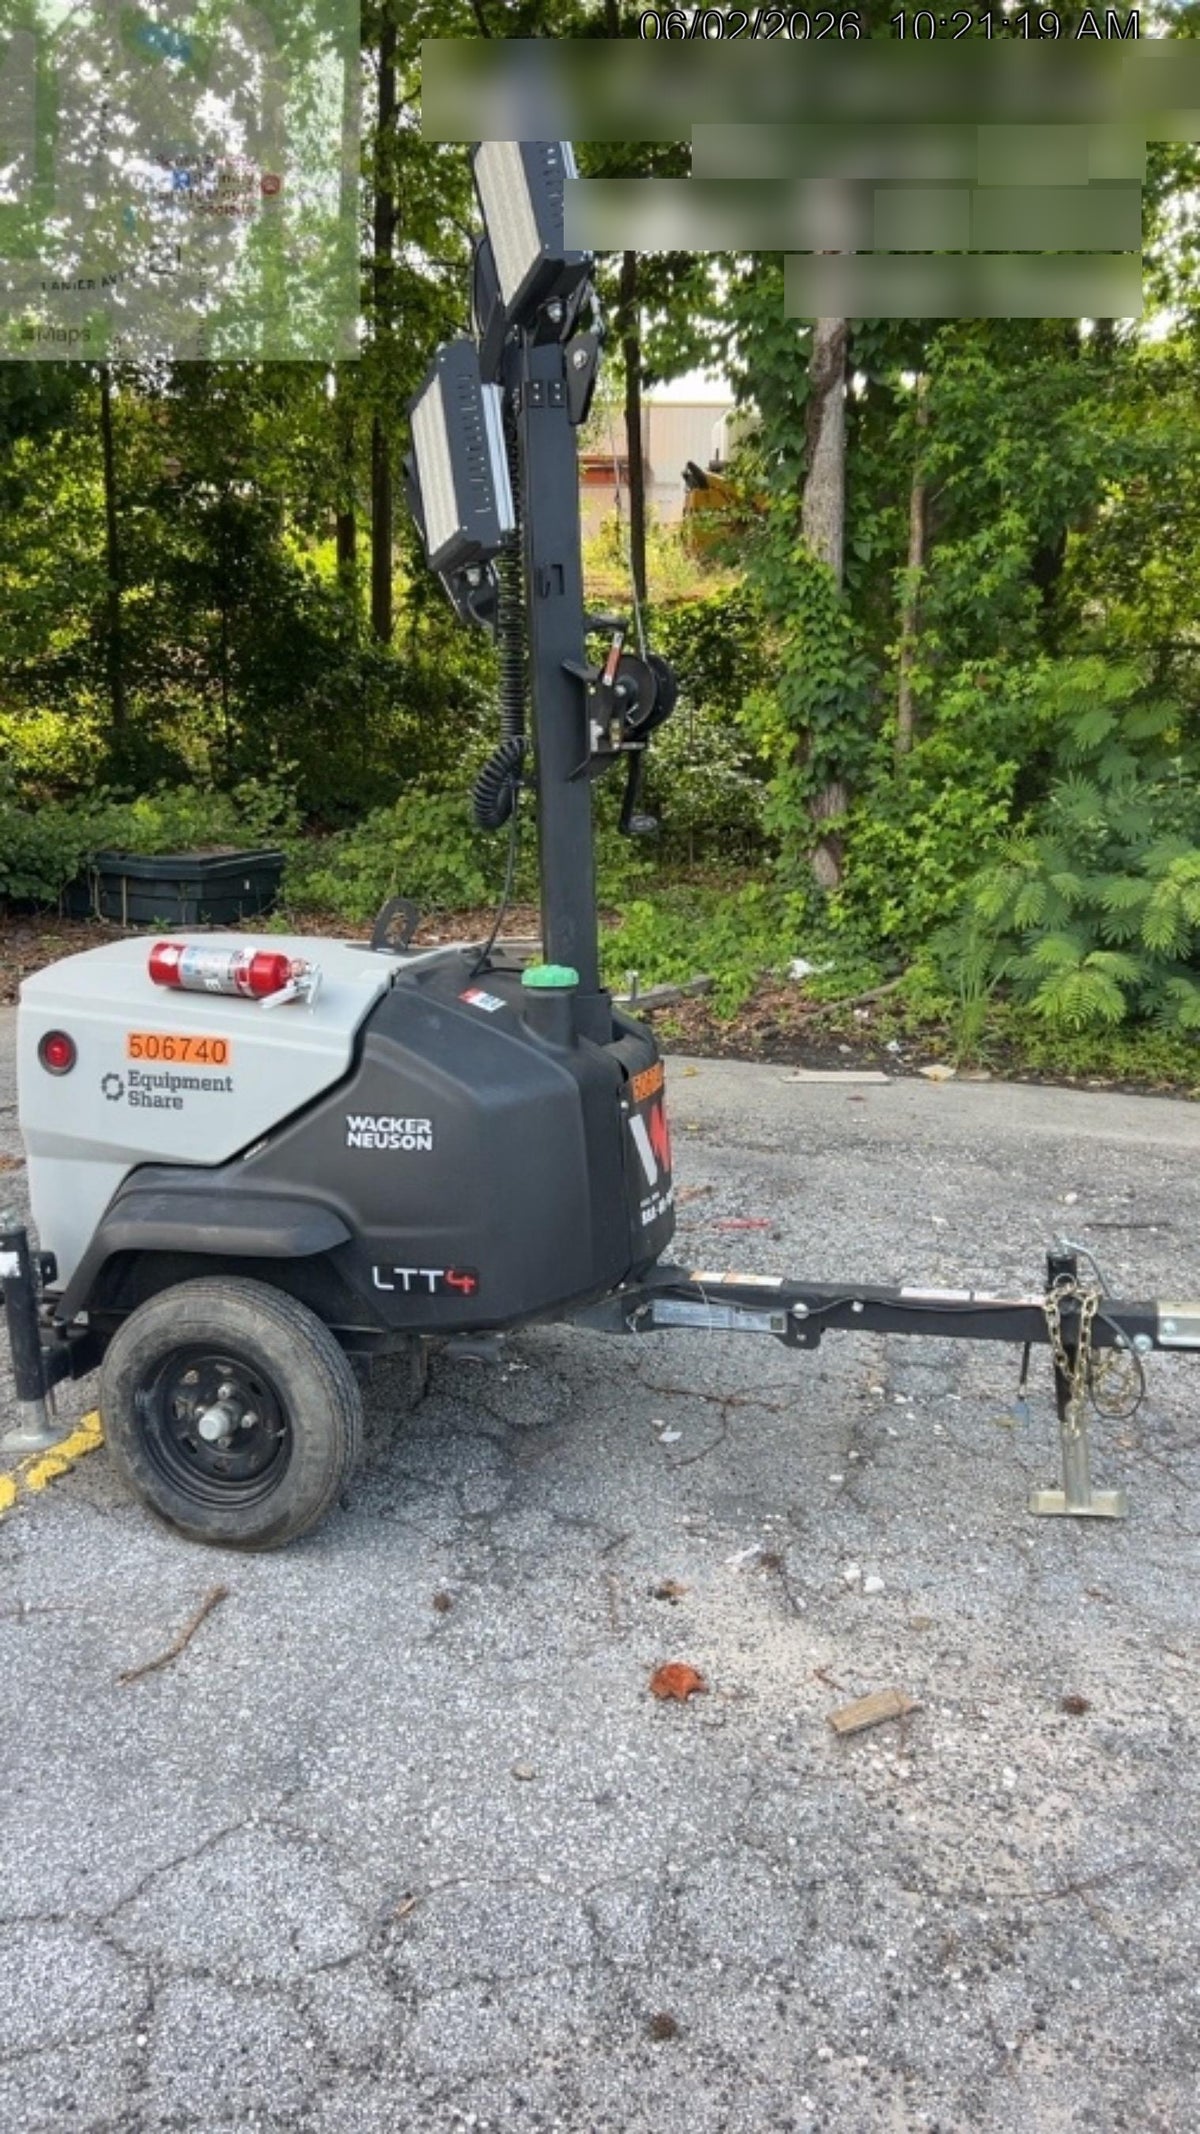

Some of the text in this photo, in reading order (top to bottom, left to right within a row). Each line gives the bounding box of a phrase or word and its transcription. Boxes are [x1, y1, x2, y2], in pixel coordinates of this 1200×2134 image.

[129, 1034, 226, 1063] 506740
[127, 1069, 233, 1093] Equipment
[127, 1090, 183, 1110] Share
[346, 1114, 432, 1134] WACKER
[346, 1132, 432, 1151] NEUSON
[372, 1265, 475, 1294] LTT4
